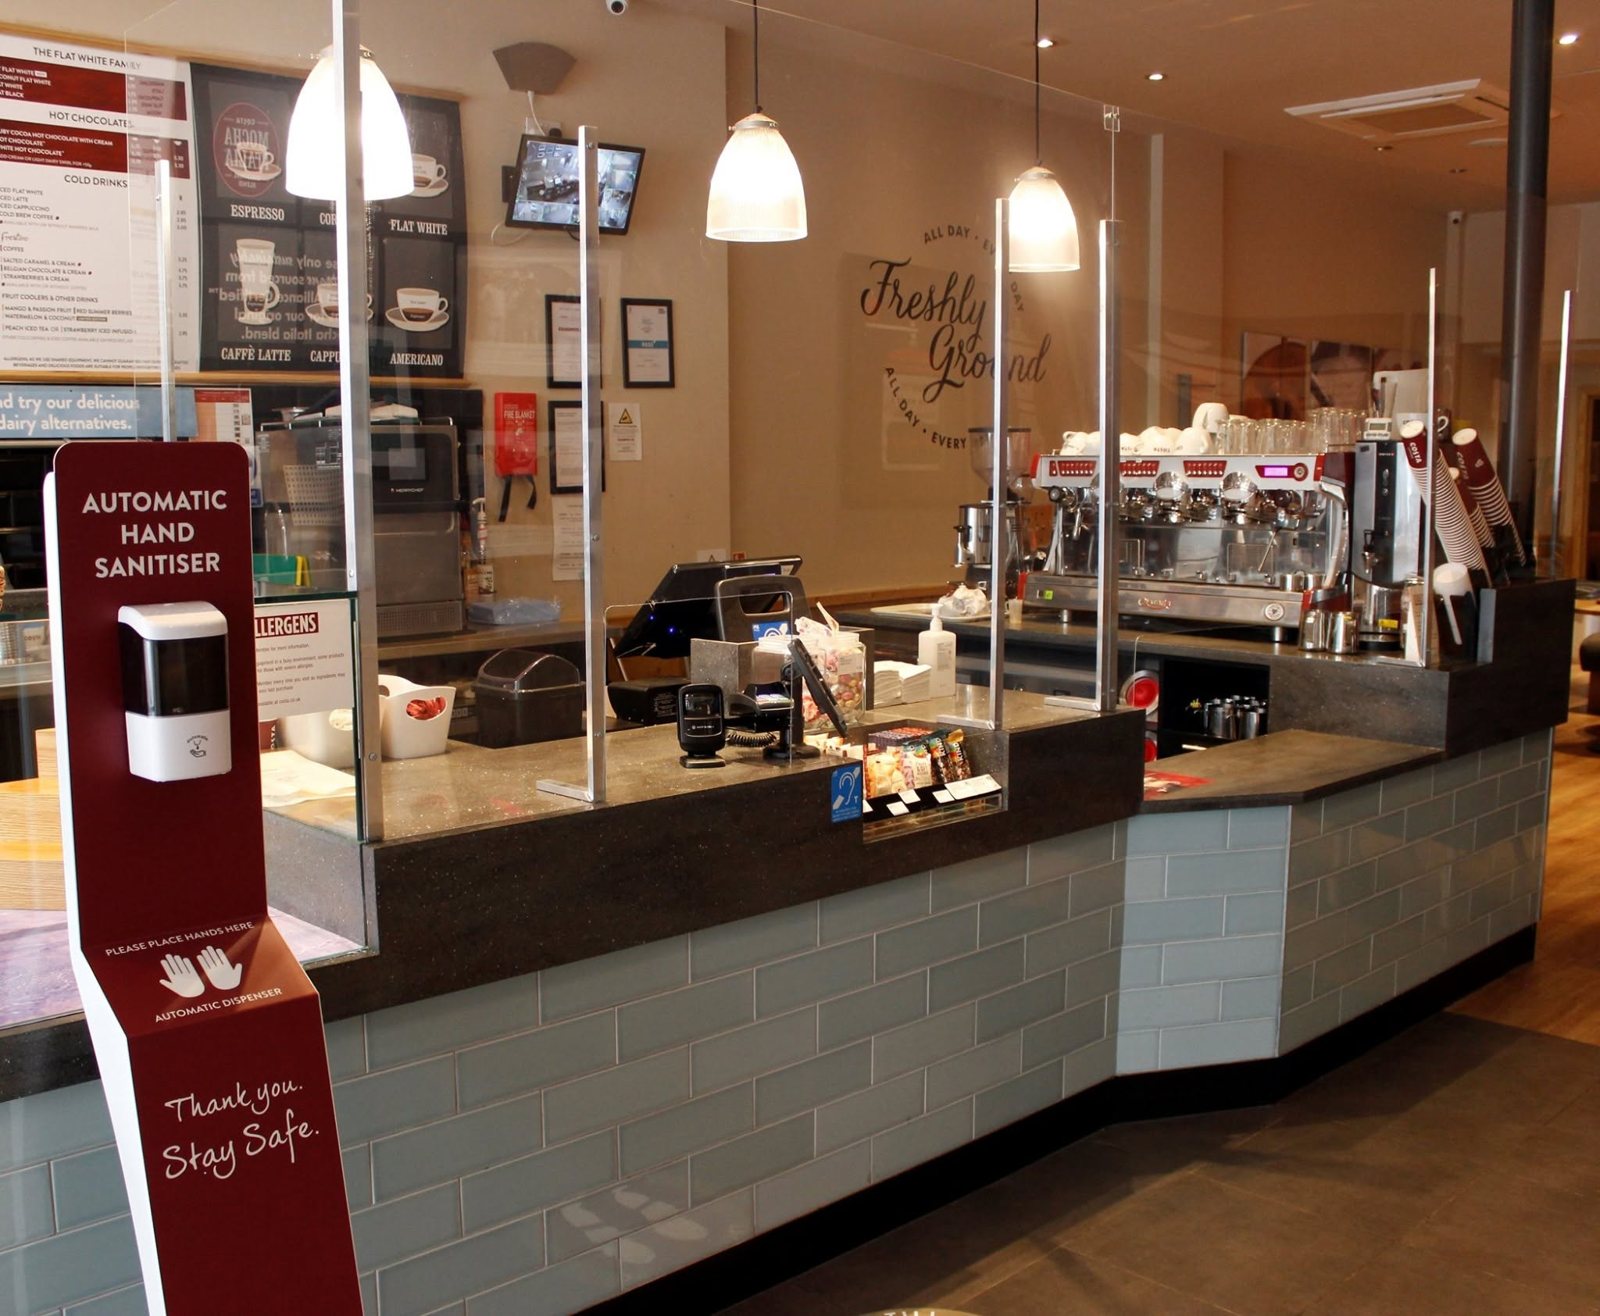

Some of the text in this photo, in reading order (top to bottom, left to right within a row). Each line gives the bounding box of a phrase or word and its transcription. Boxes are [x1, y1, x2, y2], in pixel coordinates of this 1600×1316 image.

[33, 47, 53, 58] THE
[54, 50, 76, 61] FLAT
[78, 54, 108, 65] WHITE
[20, 76, 33, 84] FLAT
[34, 78, 51, 86] WHITE
[49, 111, 69, 121] HOT
[64, 174, 128, 189] COLD DRINKS
[13, 204, 50, 212] CAPPUCCINO
[230, 204, 284, 221] ESPRESSO
[319, 212, 337, 226] COR
[390, 218, 448, 236] FLAT WHITE
[924, 224, 971, 244] ALL DAY
[3, 274, 44, 282] STRAWBERRIES
[20, 294, 48, 302] COOLERS
[860, 256, 987, 353] Freshly
[221, 344, 292, 362] CAFFÈ LATTE
[310, 350, 339, 364] CAPPU
[390, 352, 444, 366] AMERICANO
[18, 396, 42, 416] try
[46, 397, 74, 410] our
[76, 393, 140, 410] delicious
[884, 367, 967, 450] ALL DAY EVERY
[41, 414, 132, 430] alternatives.
[1410, 442, 1422, 464] COSTA
[82, 490, 228, 514] AUTOMATIC
[121, 522, 195, 544] HAND
[95, 552, 220, 578] SANITISER
[254, 614, 316, 637] LLERGENS
[105, 921, 254, 957] PLEASE PLACE HANDS HERE
[154, 988, 282, 1023] AUTOMATIC DISPENSER
[164, 1080, 304, 1122] Thank you.
[162, 1108, 320, 1180] Stay Safe.
